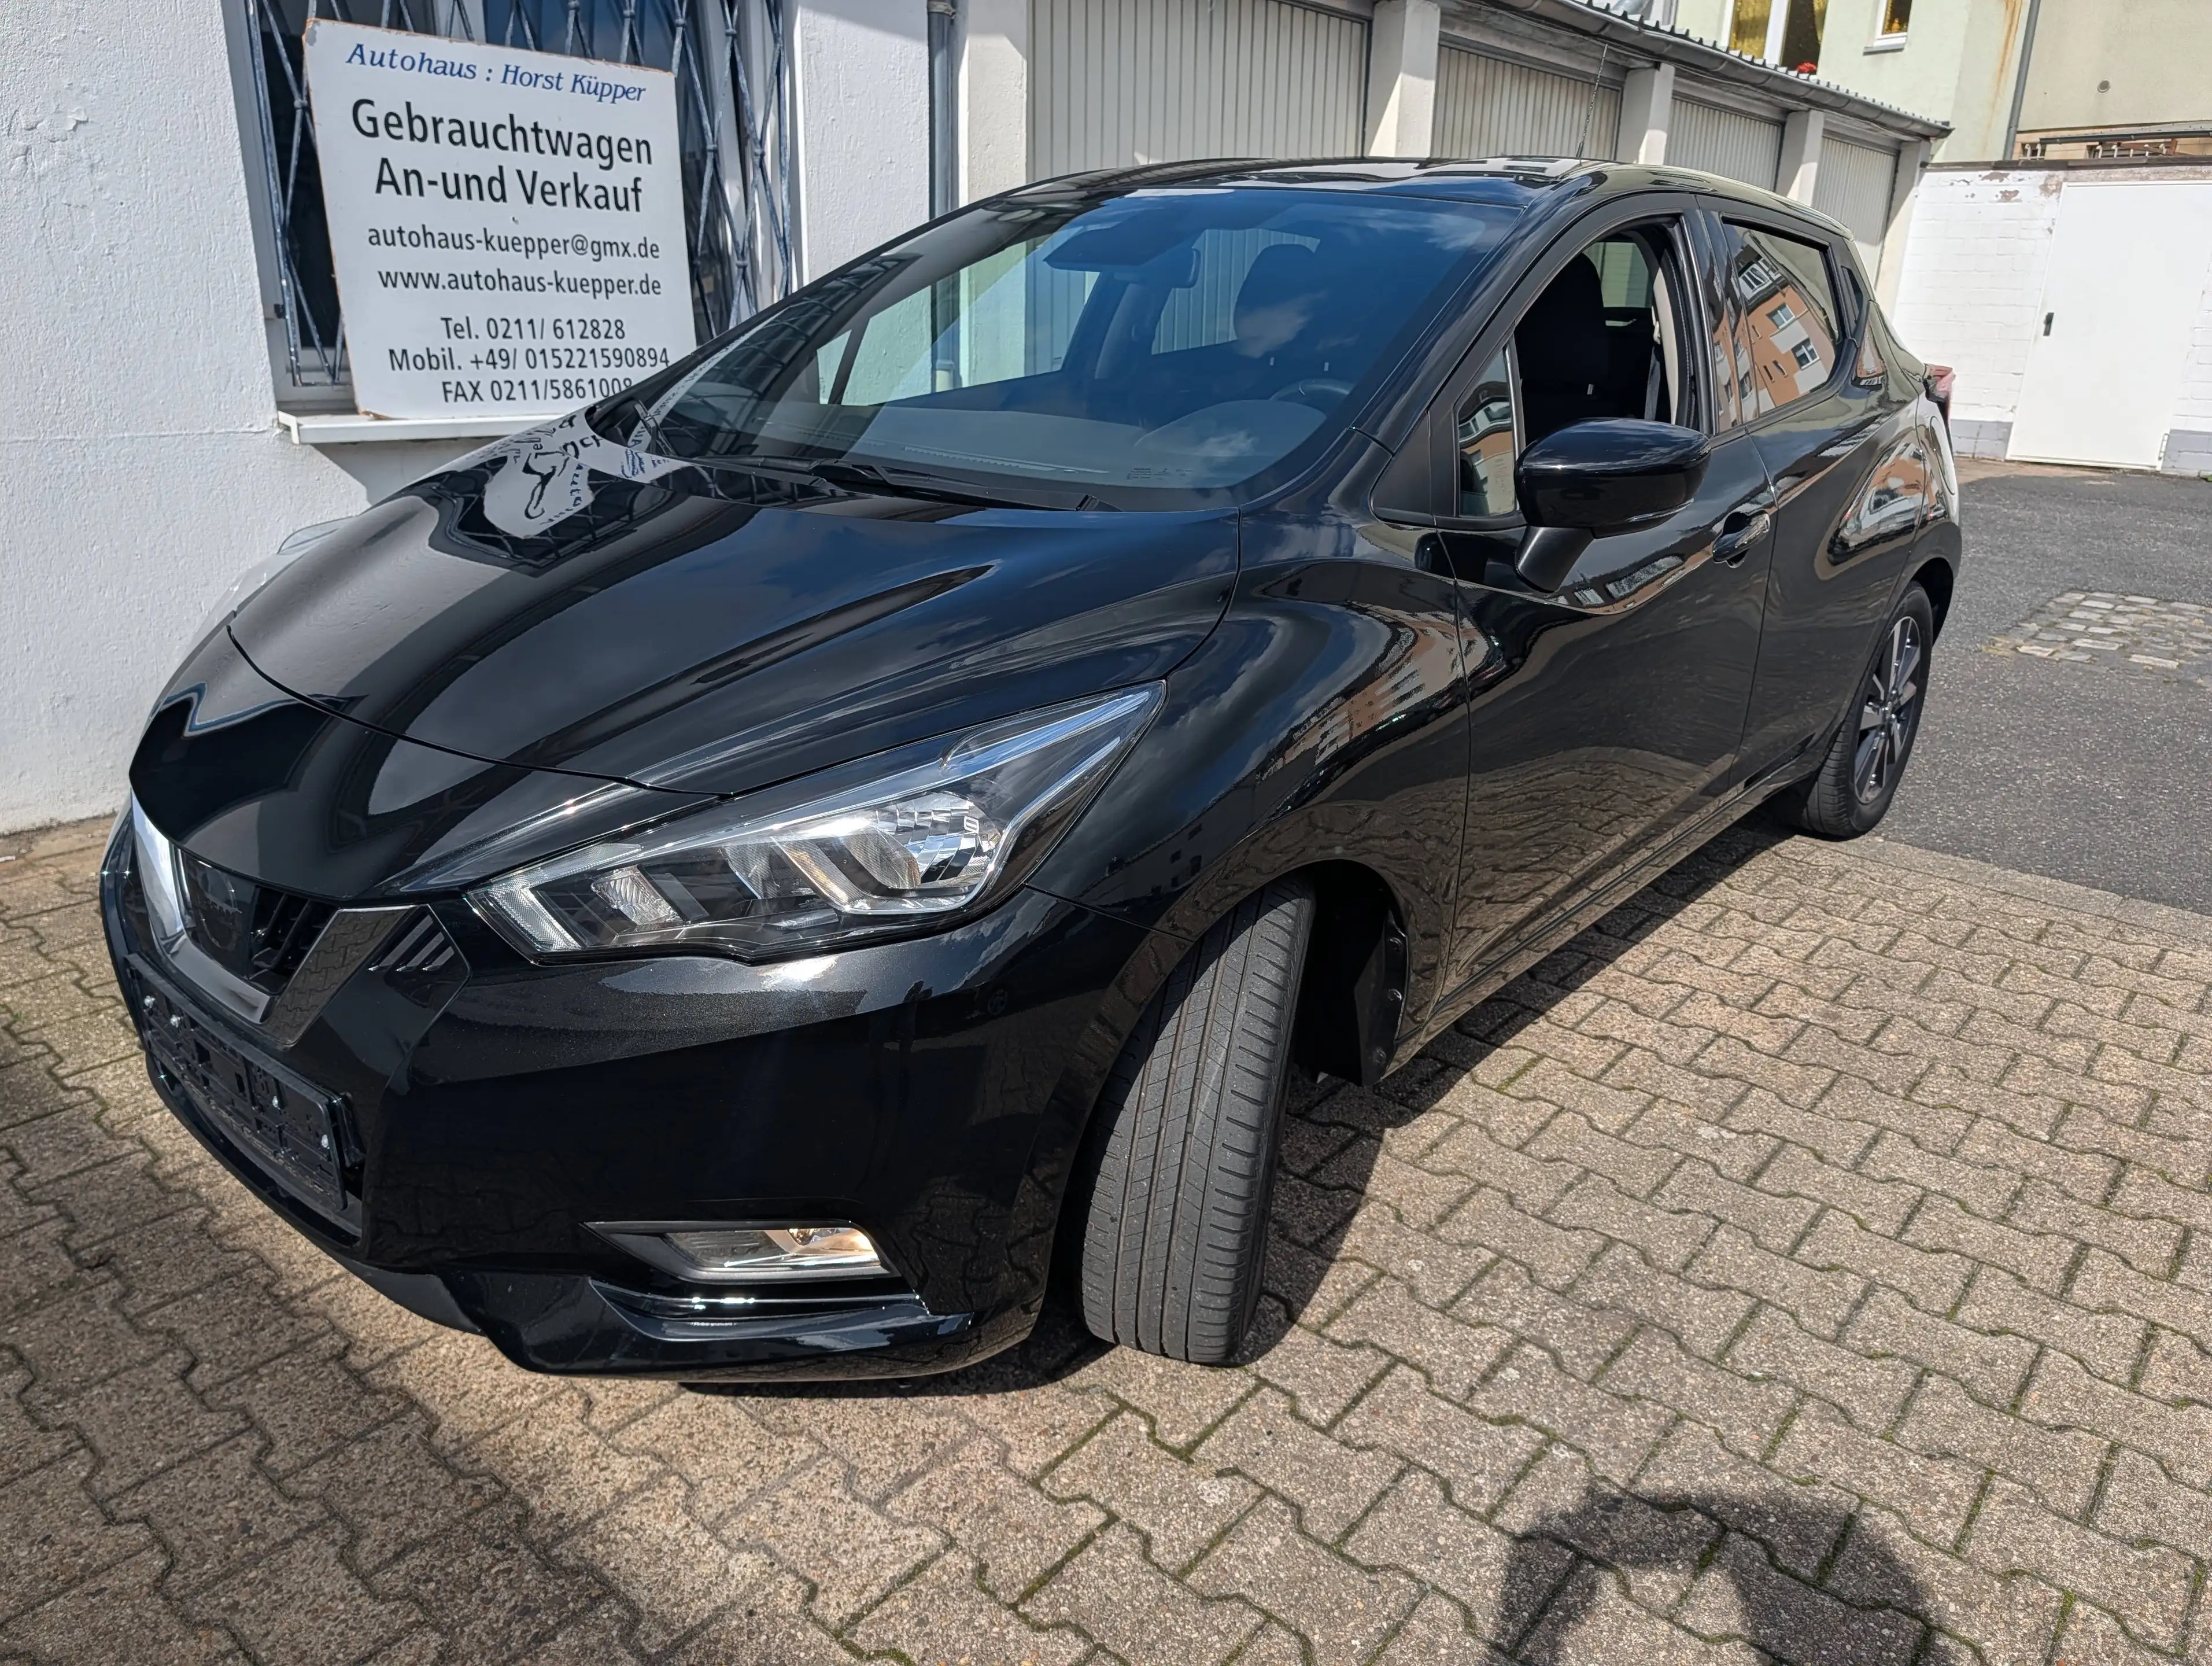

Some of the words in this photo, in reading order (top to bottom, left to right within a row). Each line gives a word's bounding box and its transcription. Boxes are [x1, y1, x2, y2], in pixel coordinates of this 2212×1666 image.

[345, 43, 477, 79] Autohaus
[501, 64, 563, 91] Horst
[570, 73, 646, 104] Küpper
[352, 98, 652, 169] Gebrauchtwagen
[375, 157, 508, 203] An-und
[515, 169, 642, 212] Verkauf
[368, 224, 659, 261] autohaus-kuepper@gmx.de
[378, 268, 661, 300] www.autohaus-kuepper.de
[440, 316, 479, 340] Tel.
[486, 318, 544, 340] 0211/
[553, 318, 625, 340] 612828
[388, 347, 462, 371] Mobil.
[470, 348, 517, 370] +49/
[525, 348, 670, 370] 015221590894
[442, 381, 484, 403] FAX
